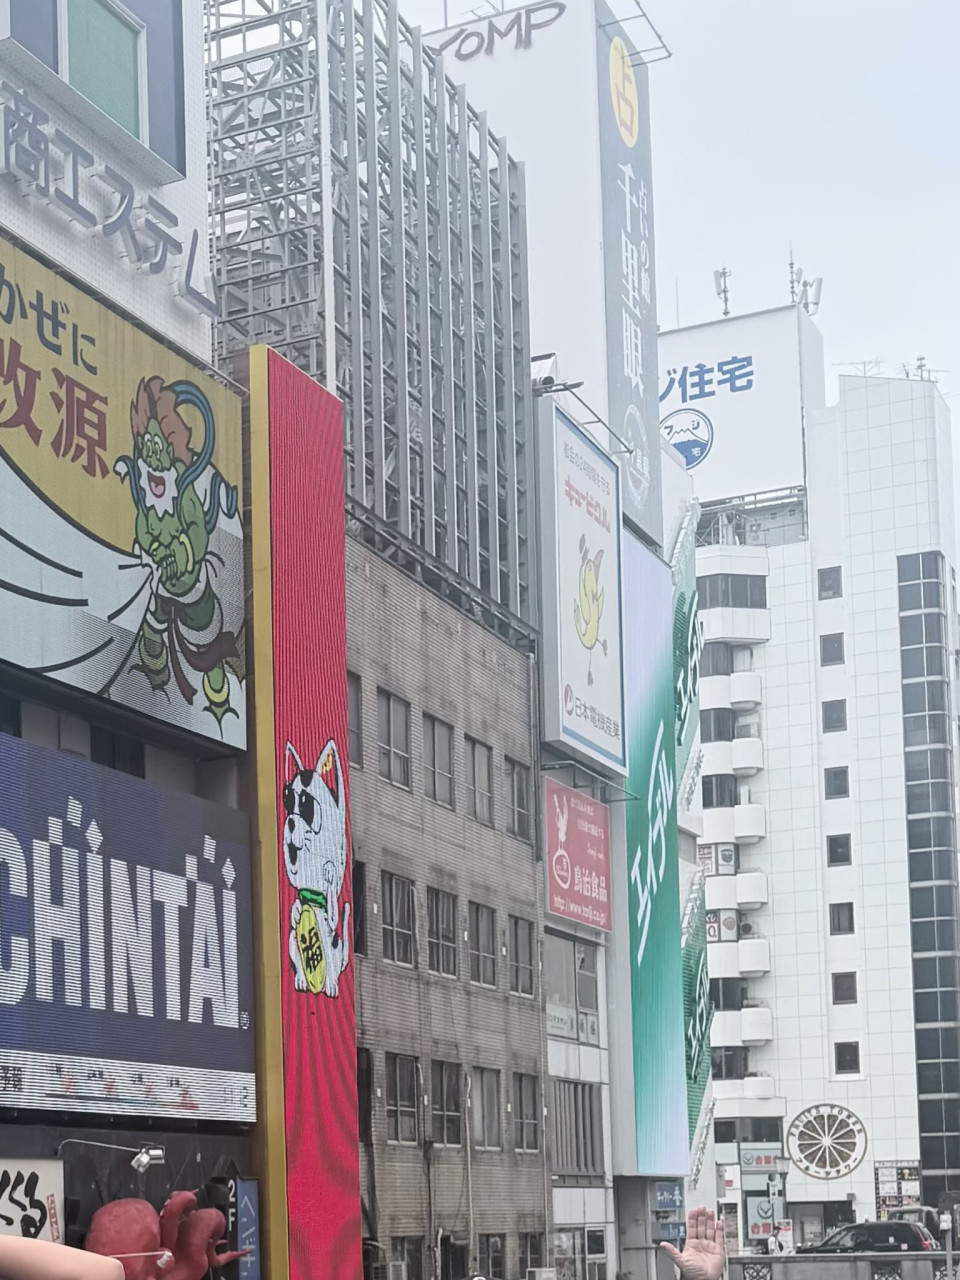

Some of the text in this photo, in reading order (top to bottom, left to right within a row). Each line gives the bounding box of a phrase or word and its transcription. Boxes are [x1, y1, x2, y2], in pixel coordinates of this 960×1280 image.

[617, 162, 644, 399] 千里眼
[630, 718, 675, 968] エイブル
[789, 1105, 864, 1137] FRUITS TOWER
[227, 1179, 236, 1232] 2F
